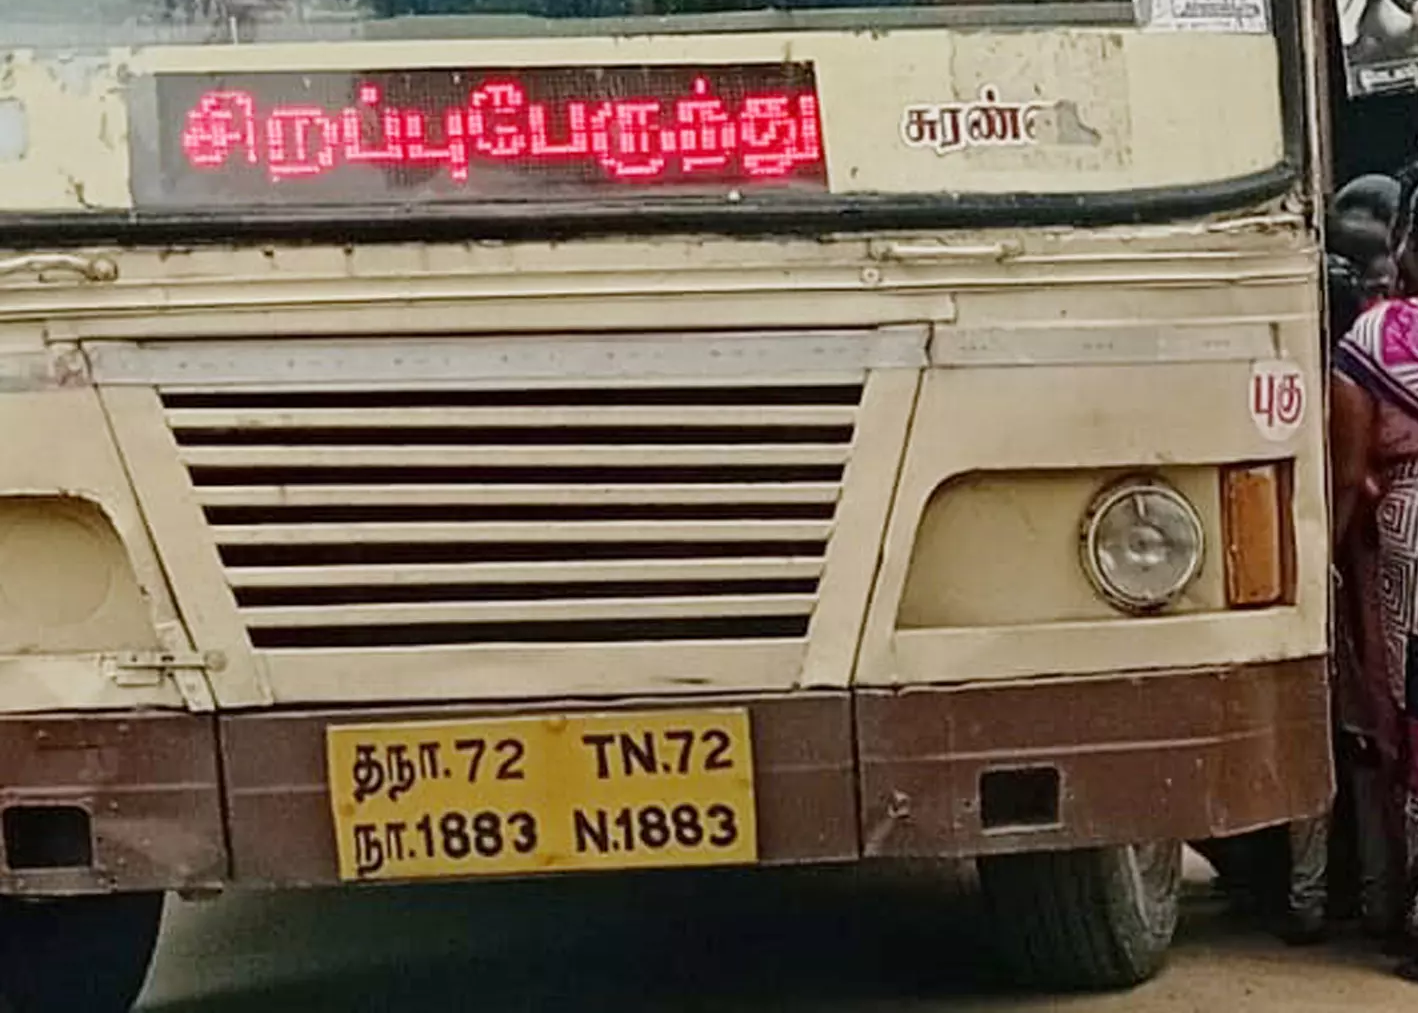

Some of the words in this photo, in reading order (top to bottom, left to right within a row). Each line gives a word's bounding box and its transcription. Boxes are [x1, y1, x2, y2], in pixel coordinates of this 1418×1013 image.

[905, 88, 1044, 147] சுரண்
[581, 729, 734, 780] TN.72
[572, 803, 739, 854] N.1883
